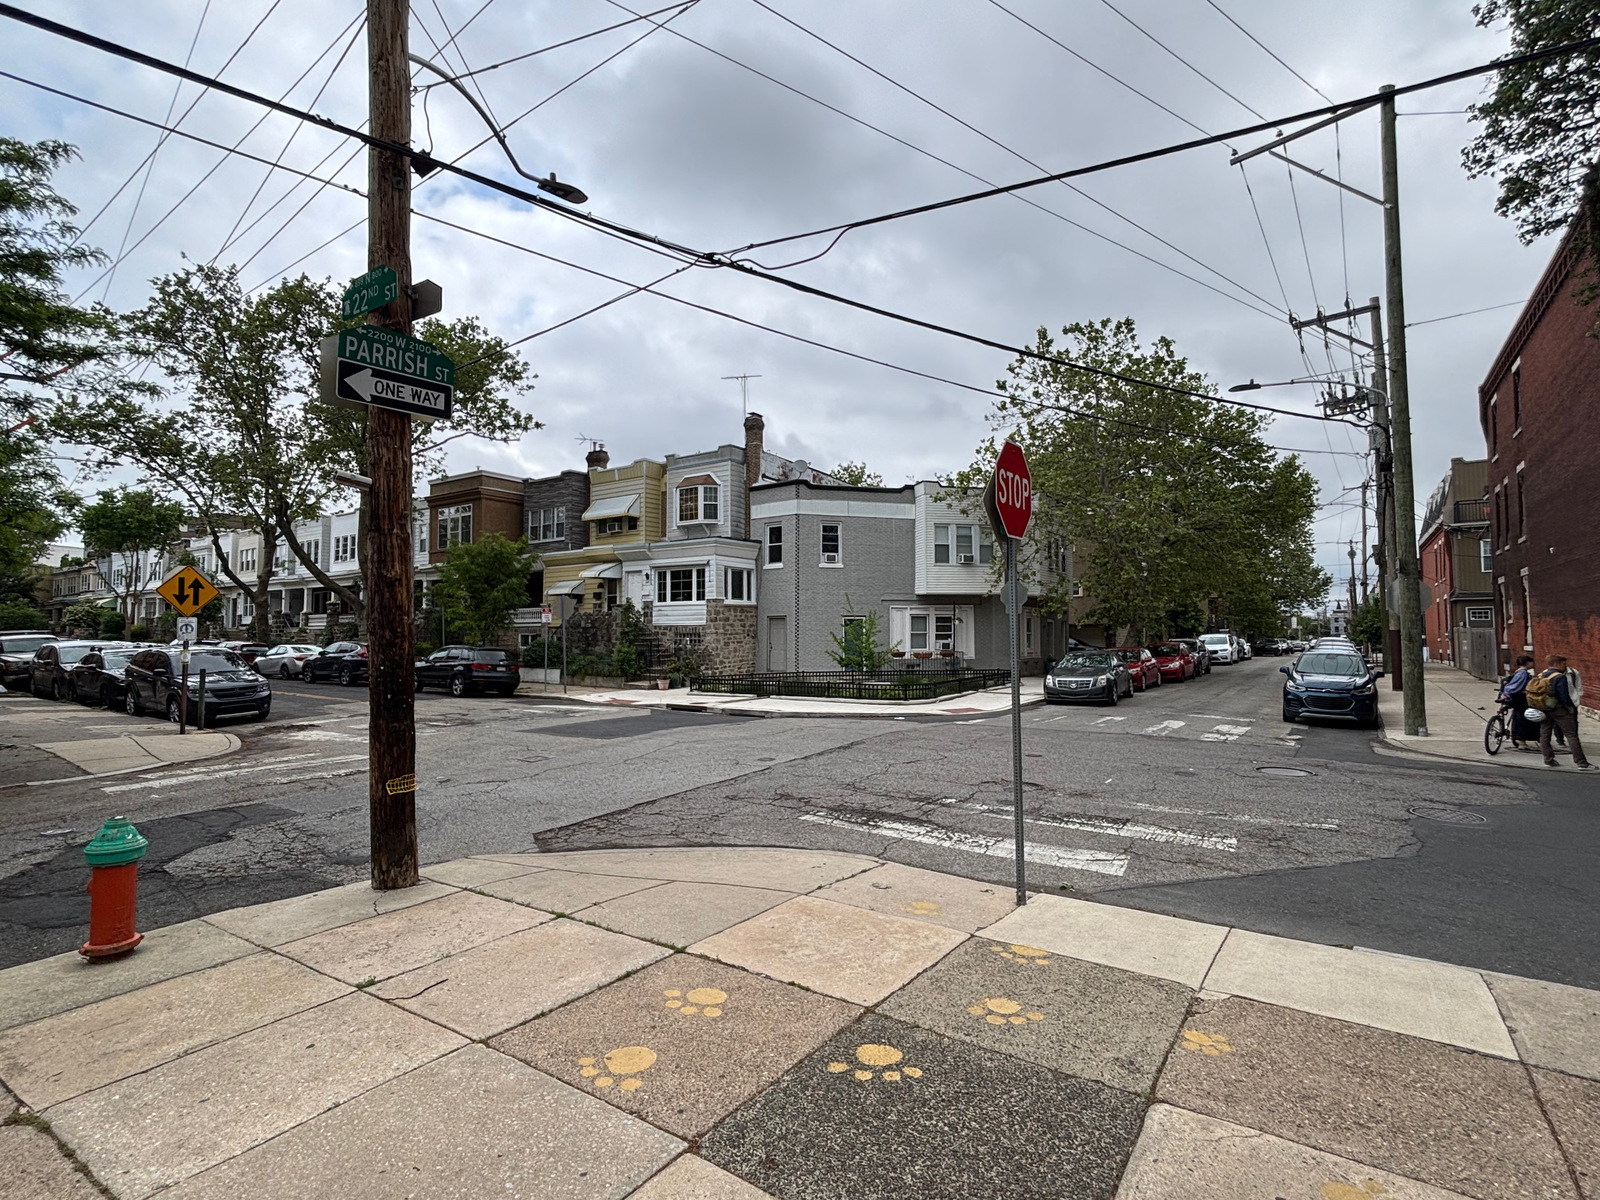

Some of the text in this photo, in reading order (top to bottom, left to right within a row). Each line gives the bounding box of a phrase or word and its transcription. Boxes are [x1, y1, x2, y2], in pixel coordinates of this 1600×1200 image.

[352, 282, 396, 315] 22ND ST
[367, 328, 432, 355] 2200 W 2100
[345, 335, 450, 382] PARRISH ST
[374, 379, 442, 407] ONE WAY
[998, 468, 1030, 511] STOP
